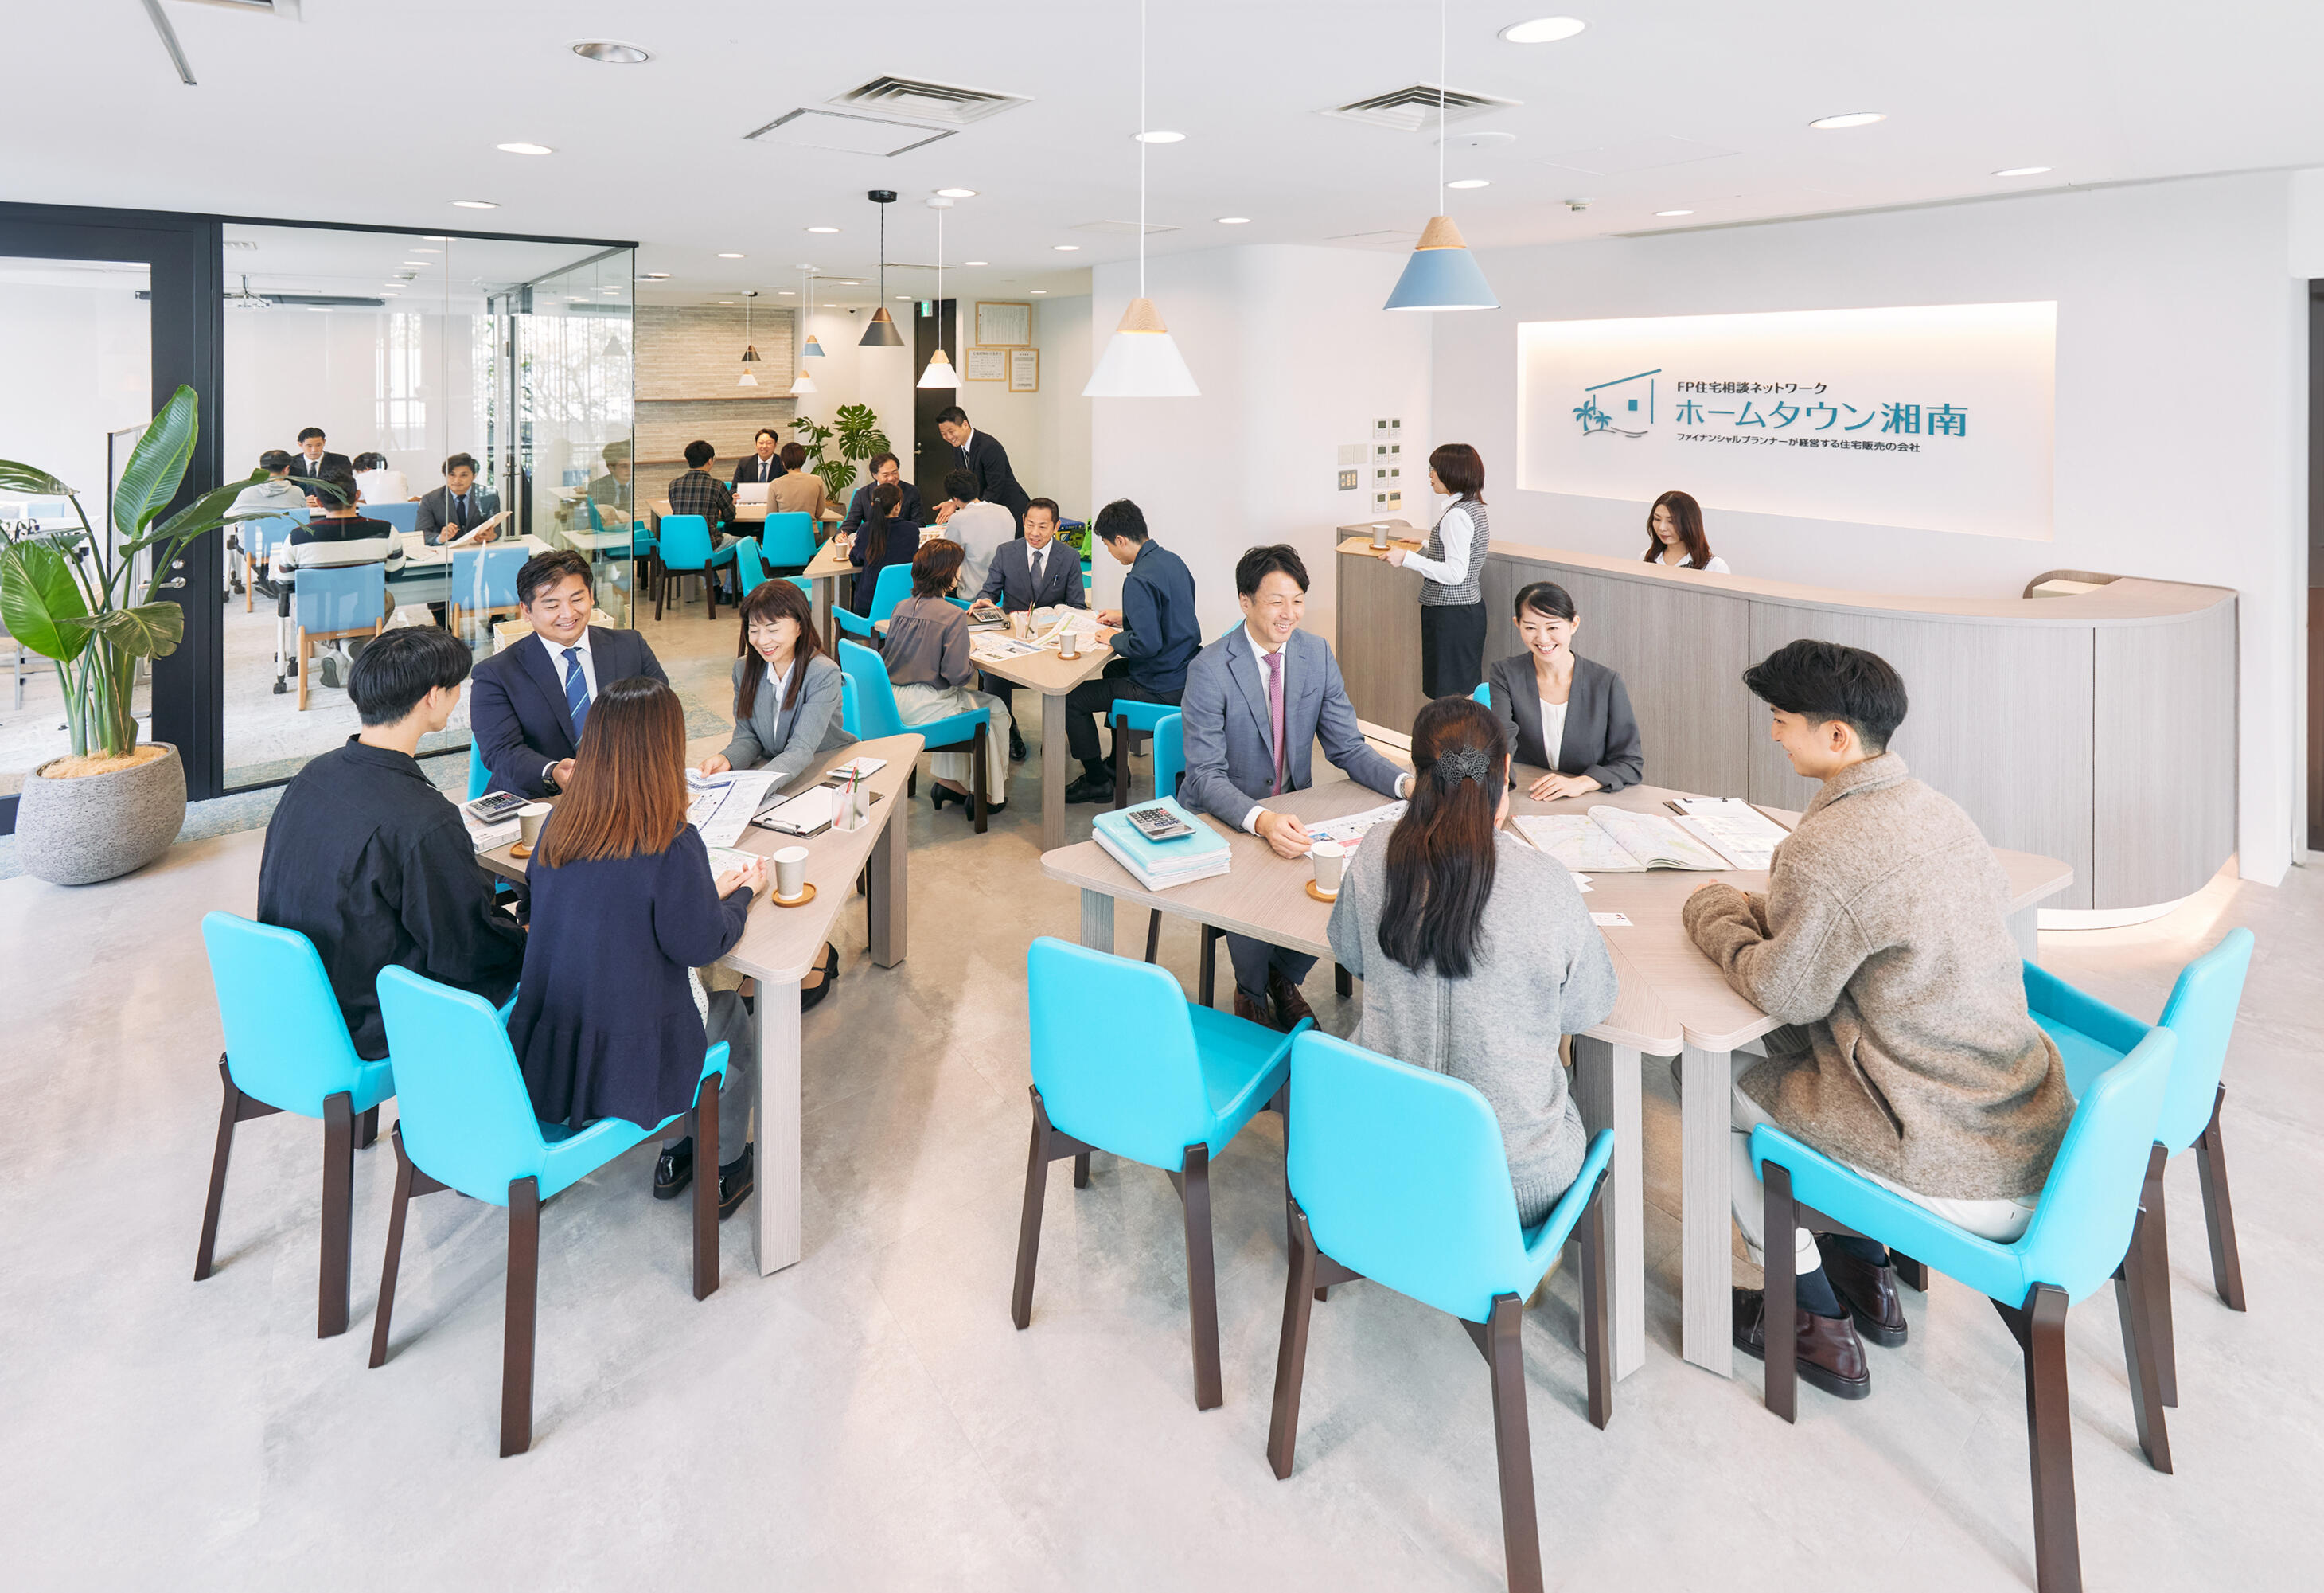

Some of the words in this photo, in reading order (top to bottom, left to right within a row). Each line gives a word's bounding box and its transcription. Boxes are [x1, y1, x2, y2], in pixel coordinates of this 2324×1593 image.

[1677, 381, 1827, 395] FP住宅相談ネットワーク
[1675, 399, 1968, 437] ホームタウン湘南
[1677, 433, 1921, 452] ファイナンシャルプランナーが経営する住宅販売の会社
